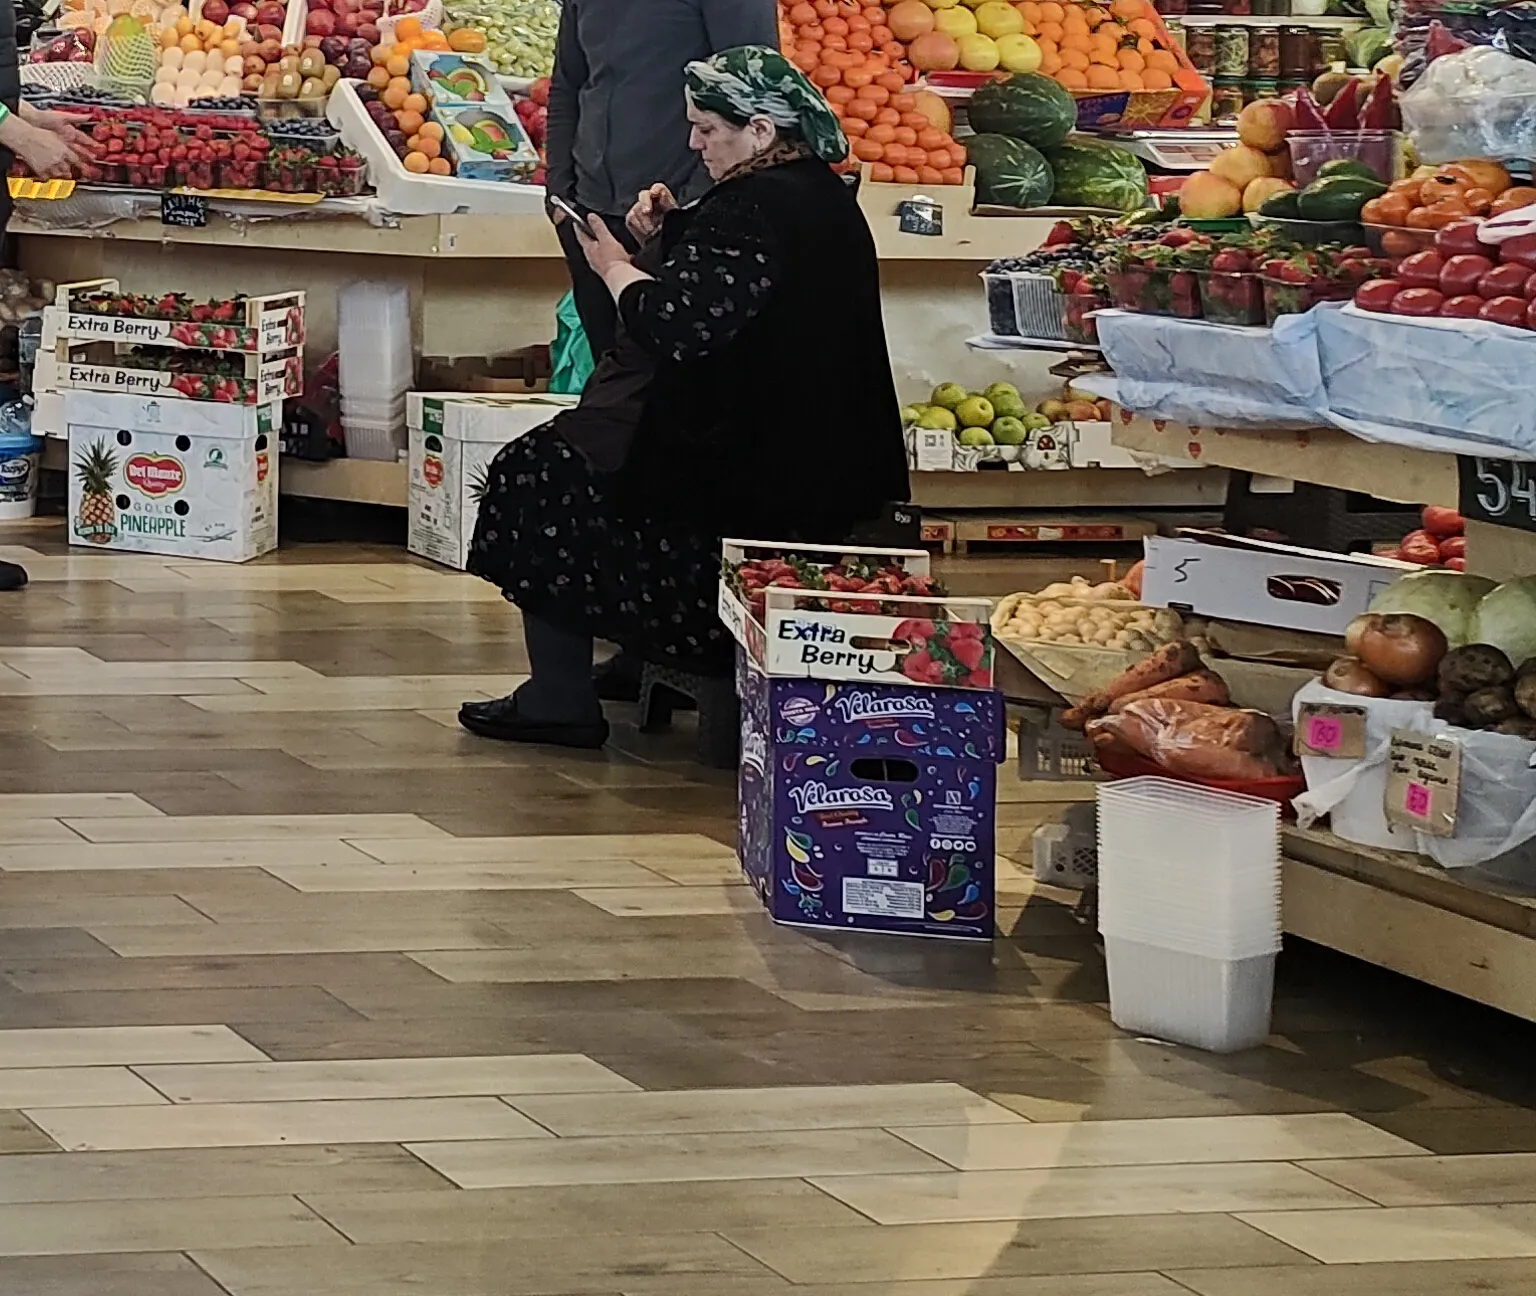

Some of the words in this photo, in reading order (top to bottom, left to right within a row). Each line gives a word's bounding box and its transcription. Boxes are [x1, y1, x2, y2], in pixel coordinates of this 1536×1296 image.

[68, 316, 109, 332] Extra
[113, 320, 162, 340] Berry
[69, 367, 111, 383] Extra
[114, 371, 164, 392] Berry
[133, 502, 173, 514] GOLD
[120, 514, 186, 538] PINEAPPLE
[1174, 557, 1202, 583] 5
[778, 619, 845, 644] Extra
[801, 644, 875, 674] Berry
[837, 692, 934, 722] Velarosa
[790, 781, 893, 812] Velarosa
